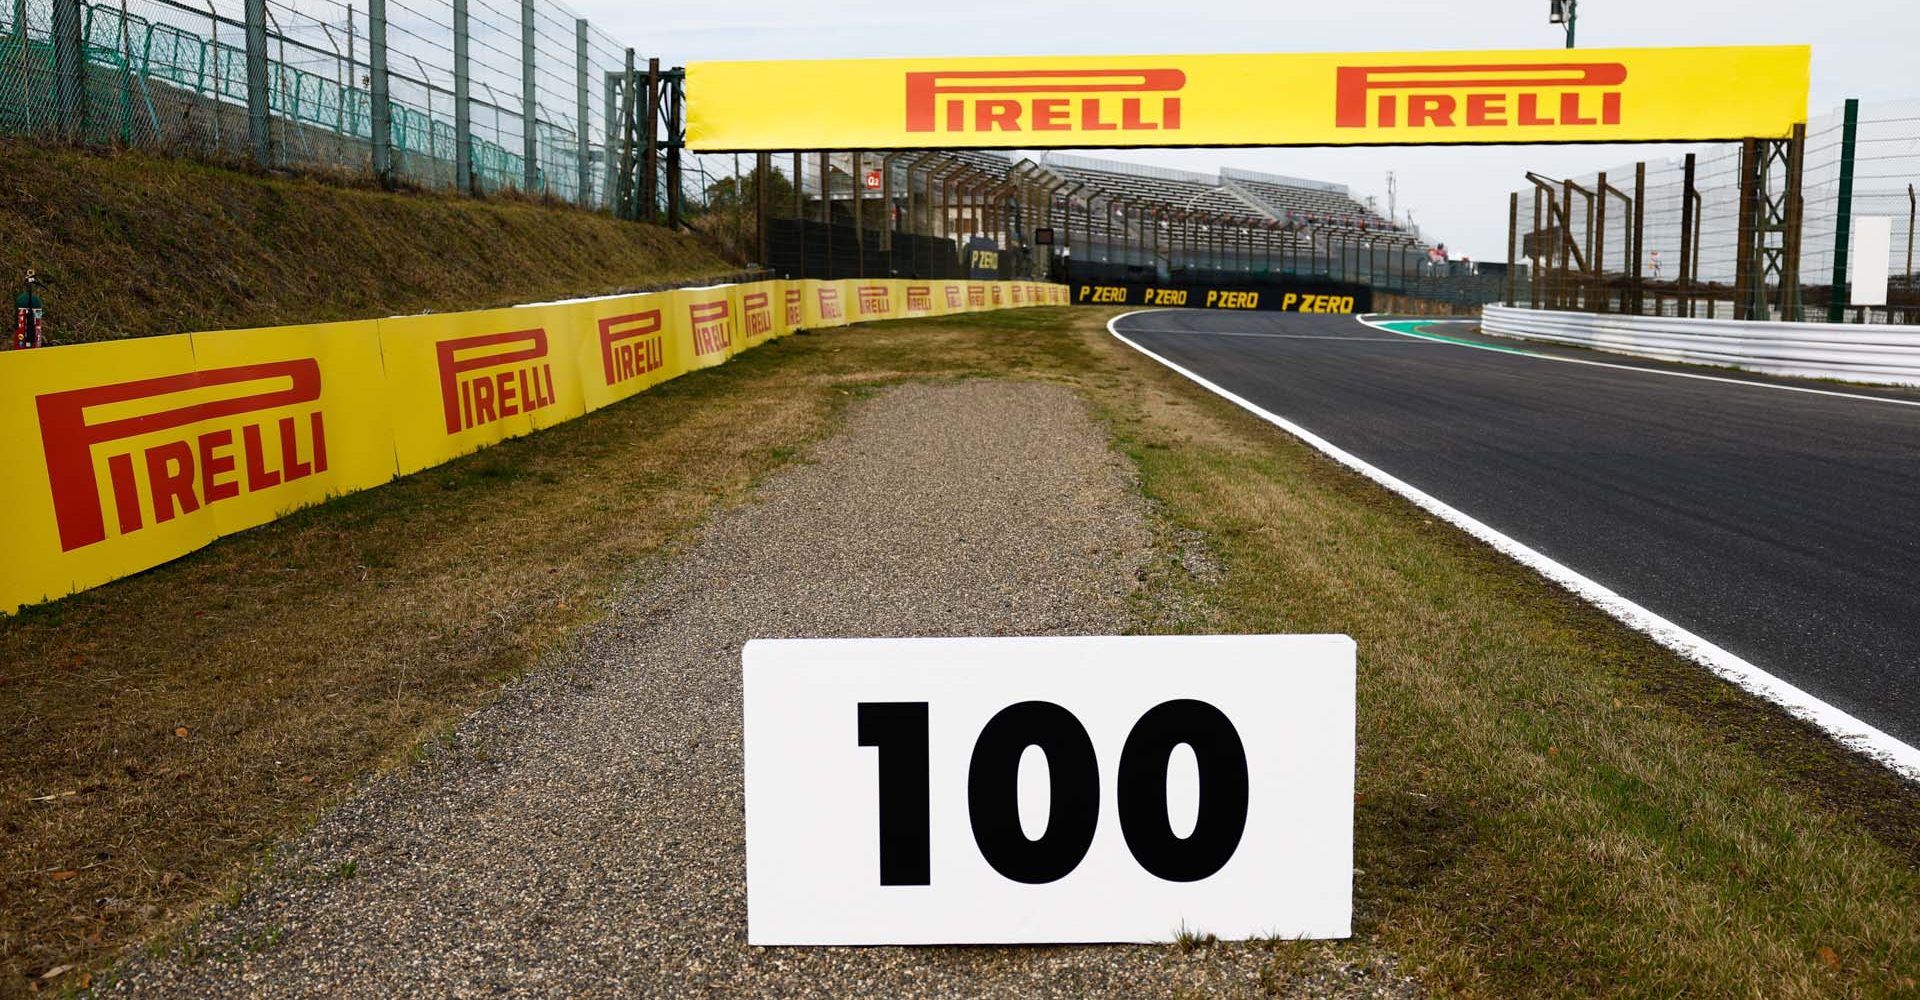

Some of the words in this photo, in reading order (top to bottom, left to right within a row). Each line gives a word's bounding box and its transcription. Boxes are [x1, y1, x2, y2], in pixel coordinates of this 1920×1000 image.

[907, 69, 1185, 132] PIRELLI
[1337, 63, 1627, 128] PIRELLI
[743, 292, 771, 338] PIRELLI
[858, 286, 890, 314] PIRELLI
[1079, 286, 1090, 301] P
[1092, 286, 1127, 302] ZERO
[1145, 288, 1154, 303] P
[1155, 289, 1187, 305] ZERO
[1206, 290, 1217, 307] P
[1218, 291, 1259, 309] ZERO
[1282, 293, 1297, 311] P
[1299, 294, 1354, 315] ZERO
[598, 309, 664, 386] PIRELLI
[689, 300, 732, 357] PIRELLI
[436, 328, 556, 435] PIRELLI
[35, 357, 329, 553] PIRELLI
[857, 699, 1249, 886] 100
